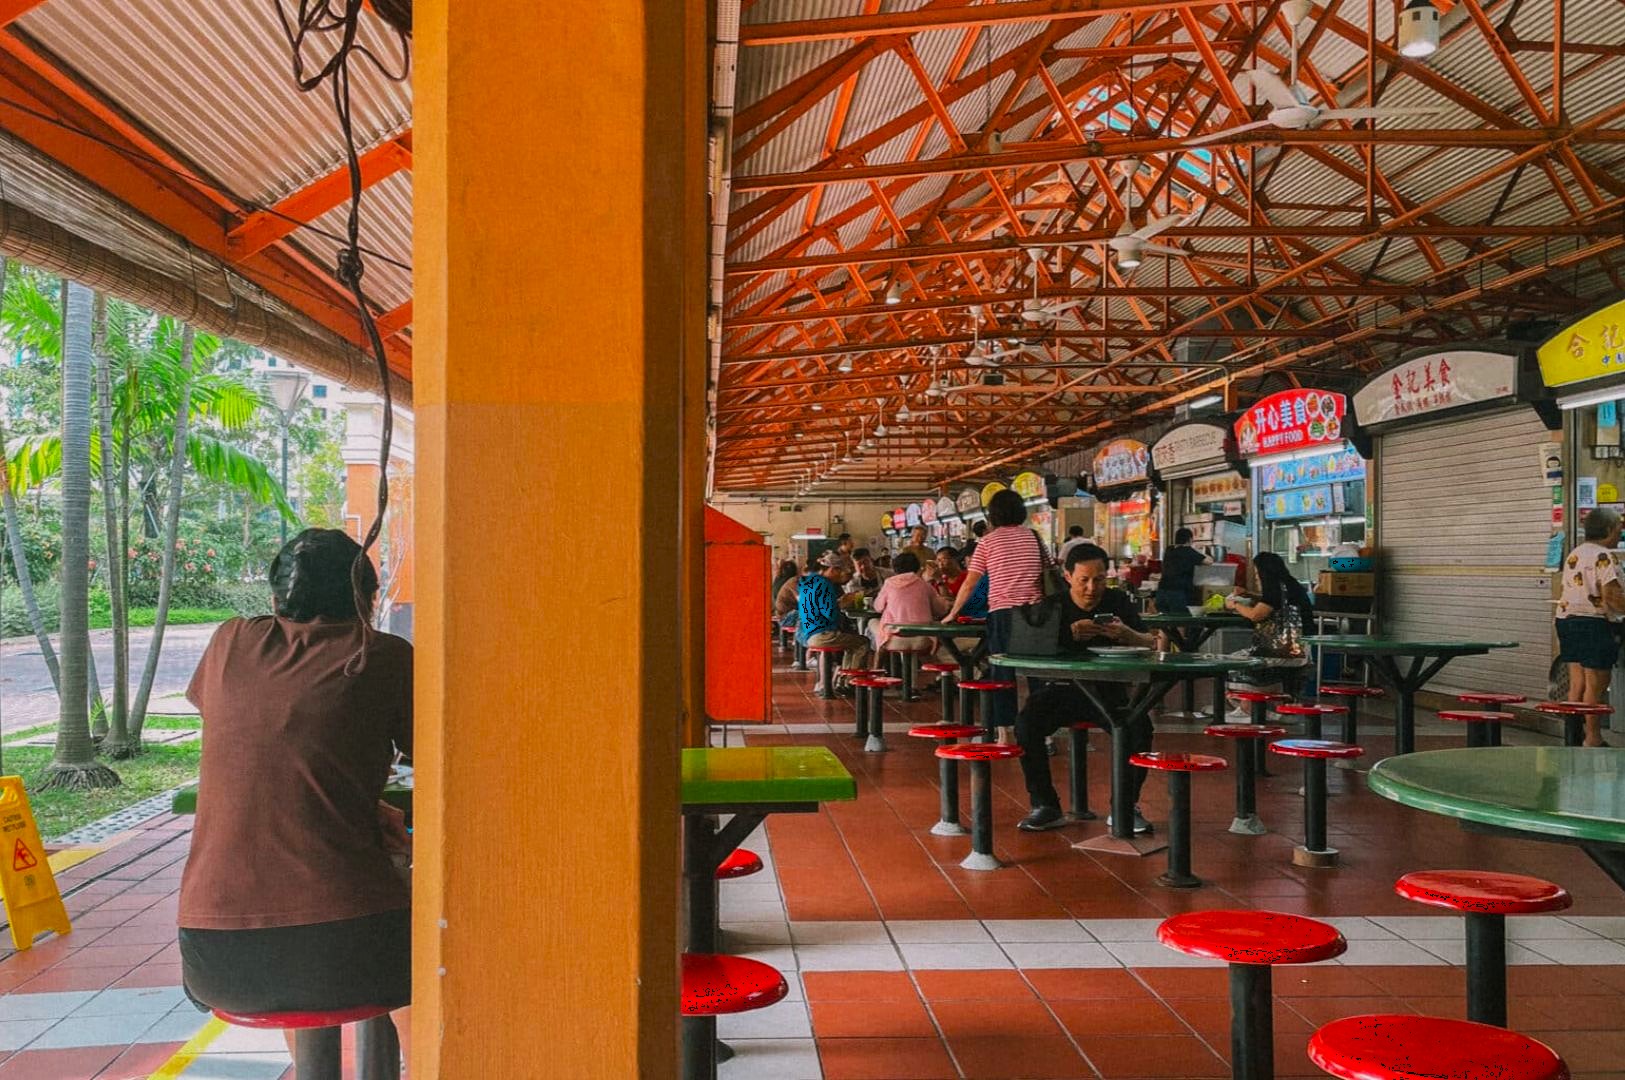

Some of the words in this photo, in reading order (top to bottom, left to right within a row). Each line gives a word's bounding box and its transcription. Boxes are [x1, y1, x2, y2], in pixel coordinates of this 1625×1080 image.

[1254, 397, 1307, 435] 开心美食
[1262, 433, 1284, 448] HAPPY
[1285, 429, 1304, 444] FOOD
